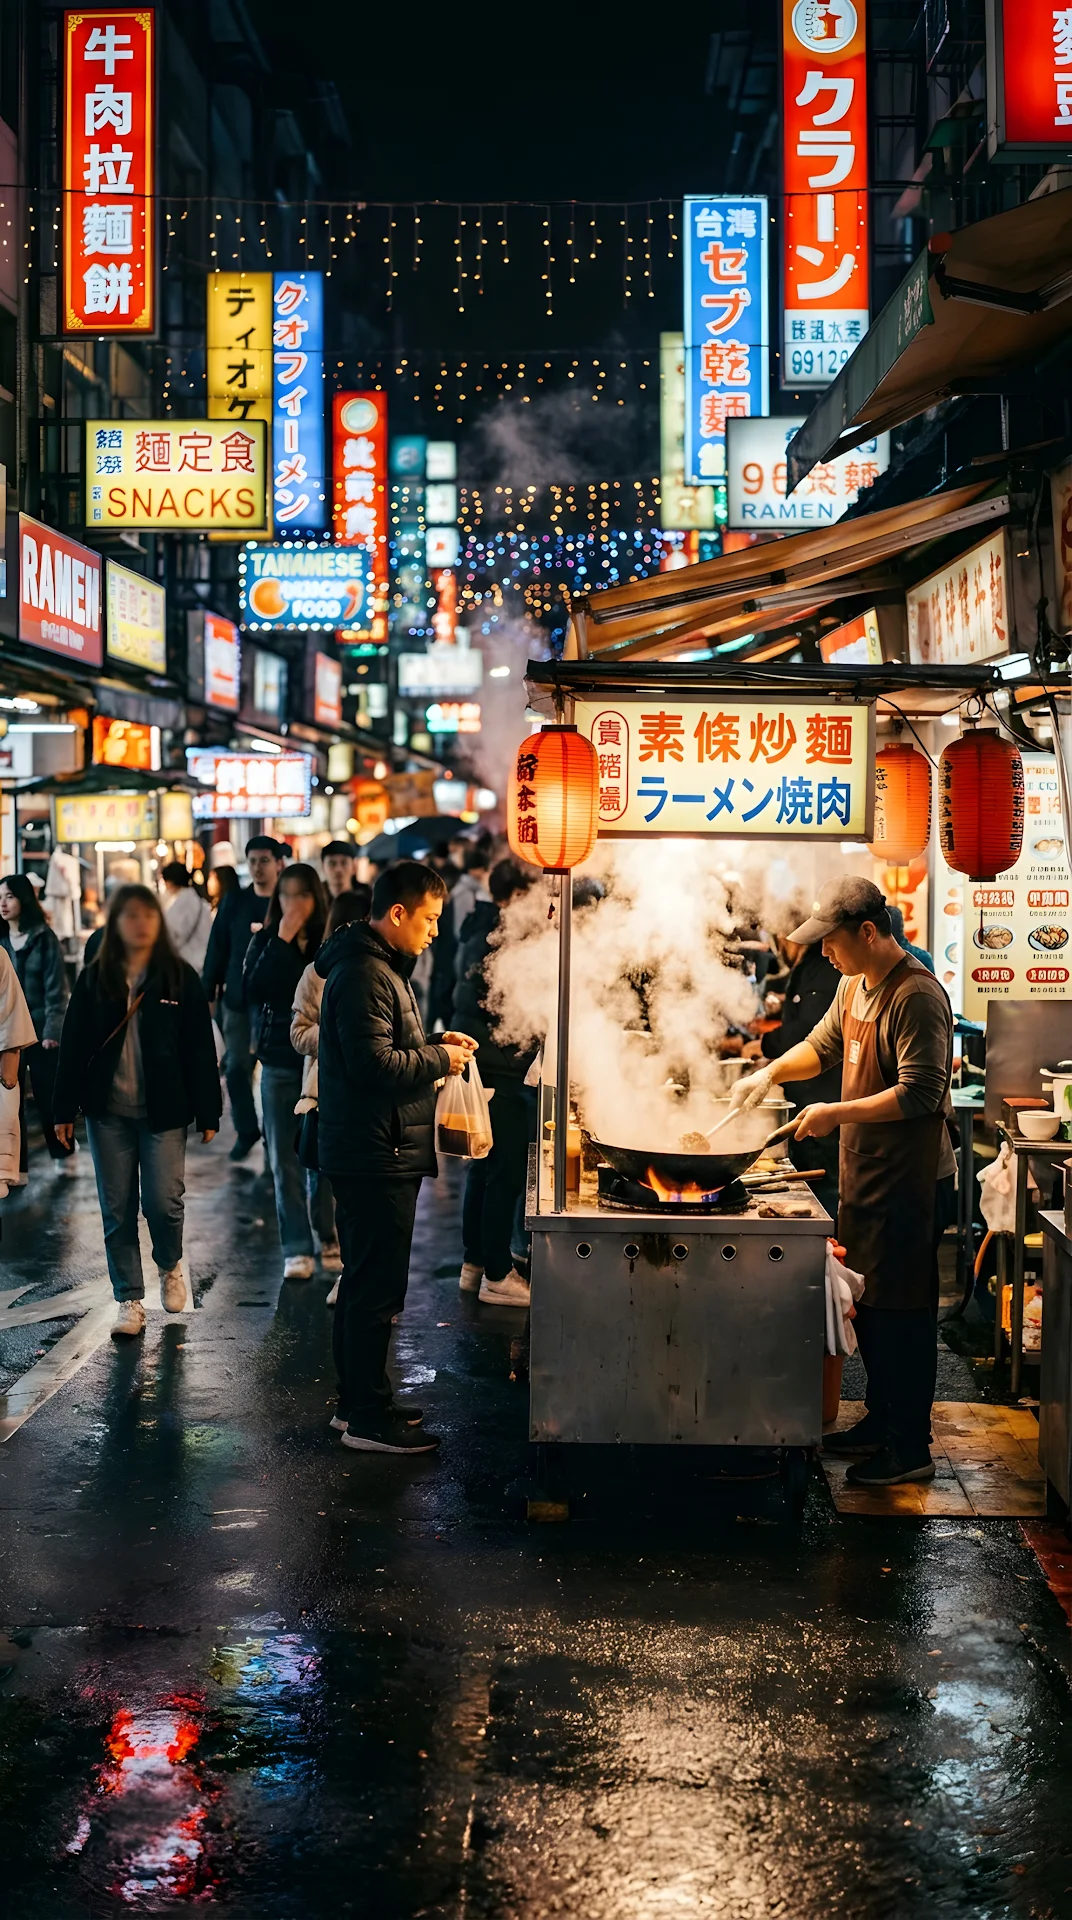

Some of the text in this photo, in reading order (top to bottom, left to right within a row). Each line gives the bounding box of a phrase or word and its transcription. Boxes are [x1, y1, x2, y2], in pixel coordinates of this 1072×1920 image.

[107, 487, 255, 518] SNACKS
[741, 503, 834, 519] RAMEN
[22, 533, 99, 632] RAMEN
[636, 776, 852, 827] ラーメン焼肉
